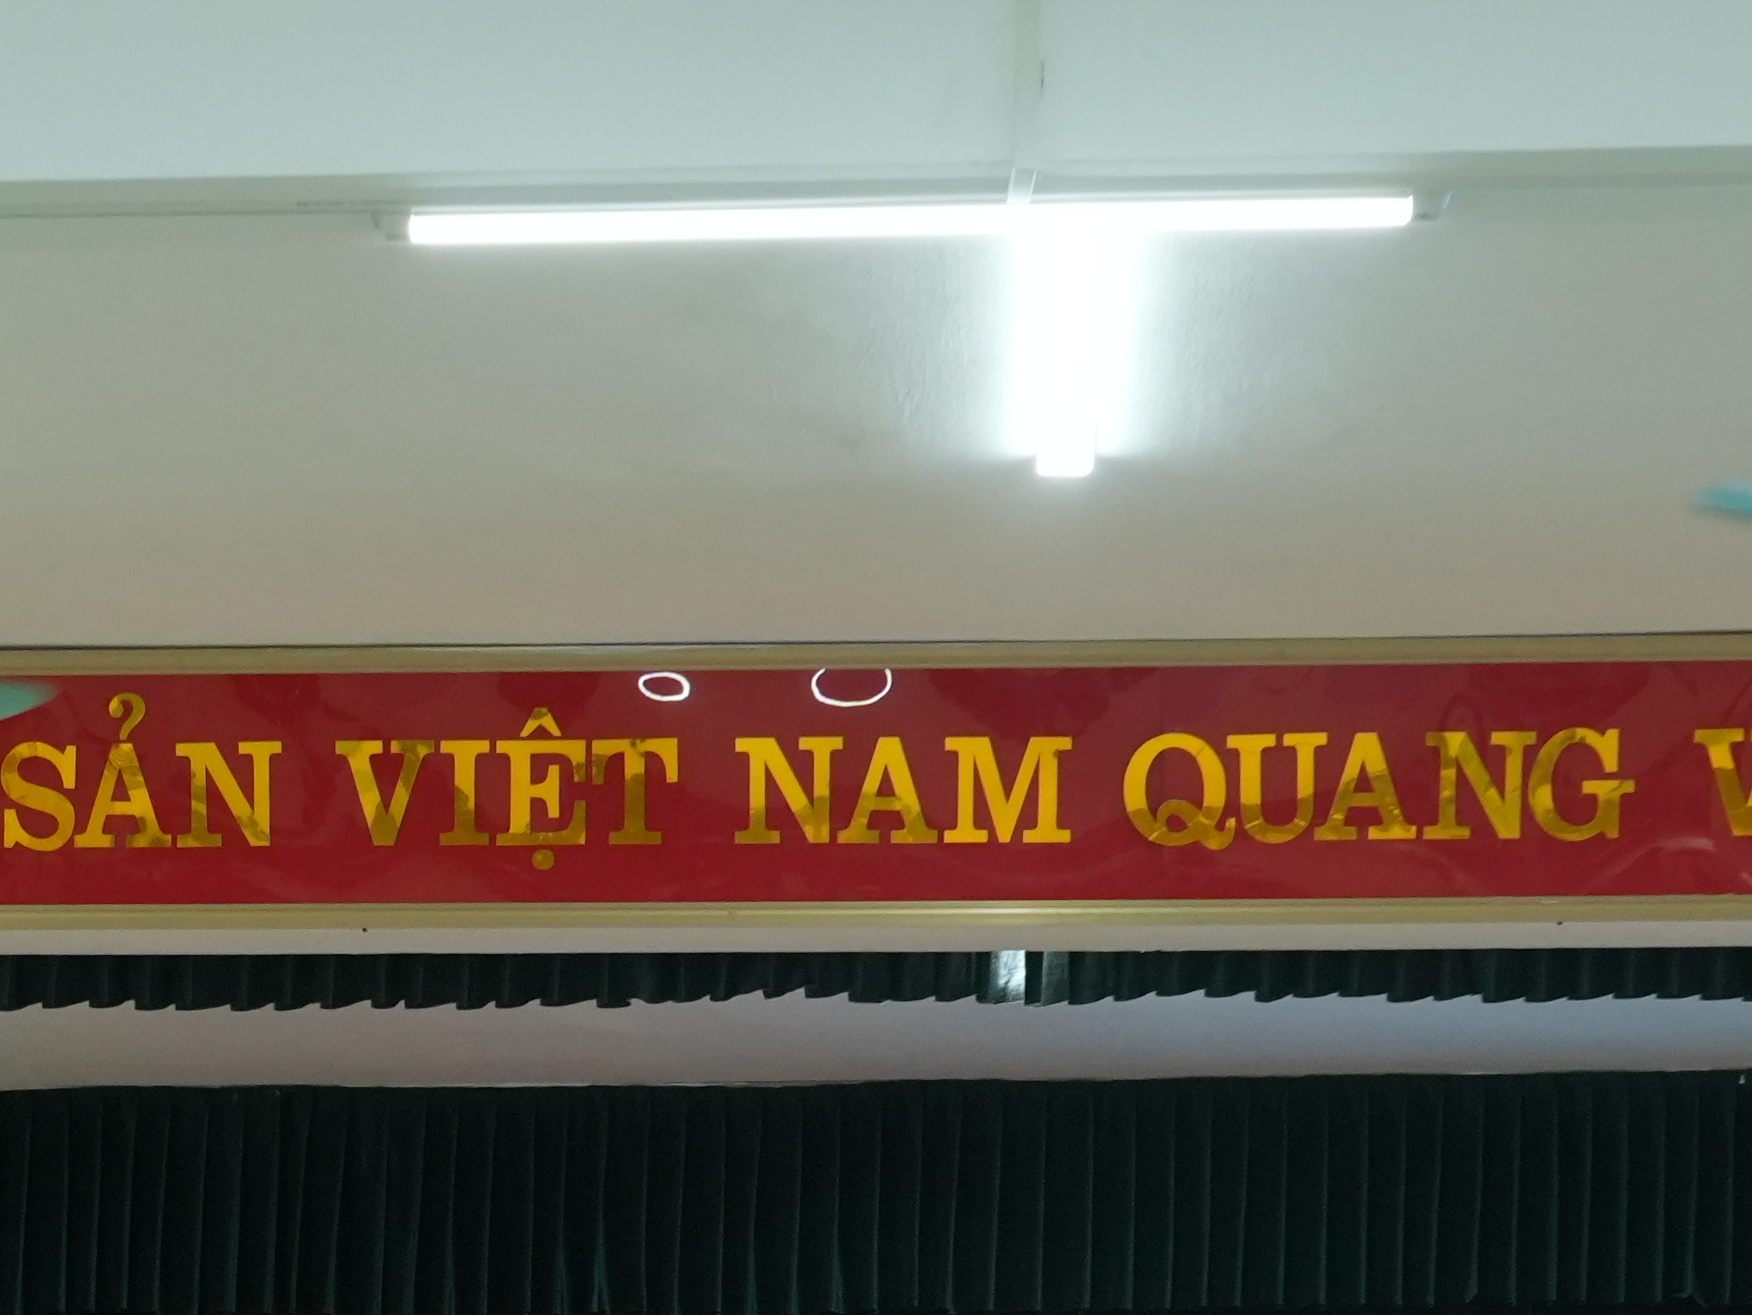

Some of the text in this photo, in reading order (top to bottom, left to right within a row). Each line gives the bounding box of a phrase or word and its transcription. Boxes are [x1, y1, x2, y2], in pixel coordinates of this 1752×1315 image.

[0, 692, 283, 853] SẢN
[335, 707, 681, 870] VIỆT
[734, 734, 1075, 845] NAM
[1123, 726, 1637, 852] QUANG
